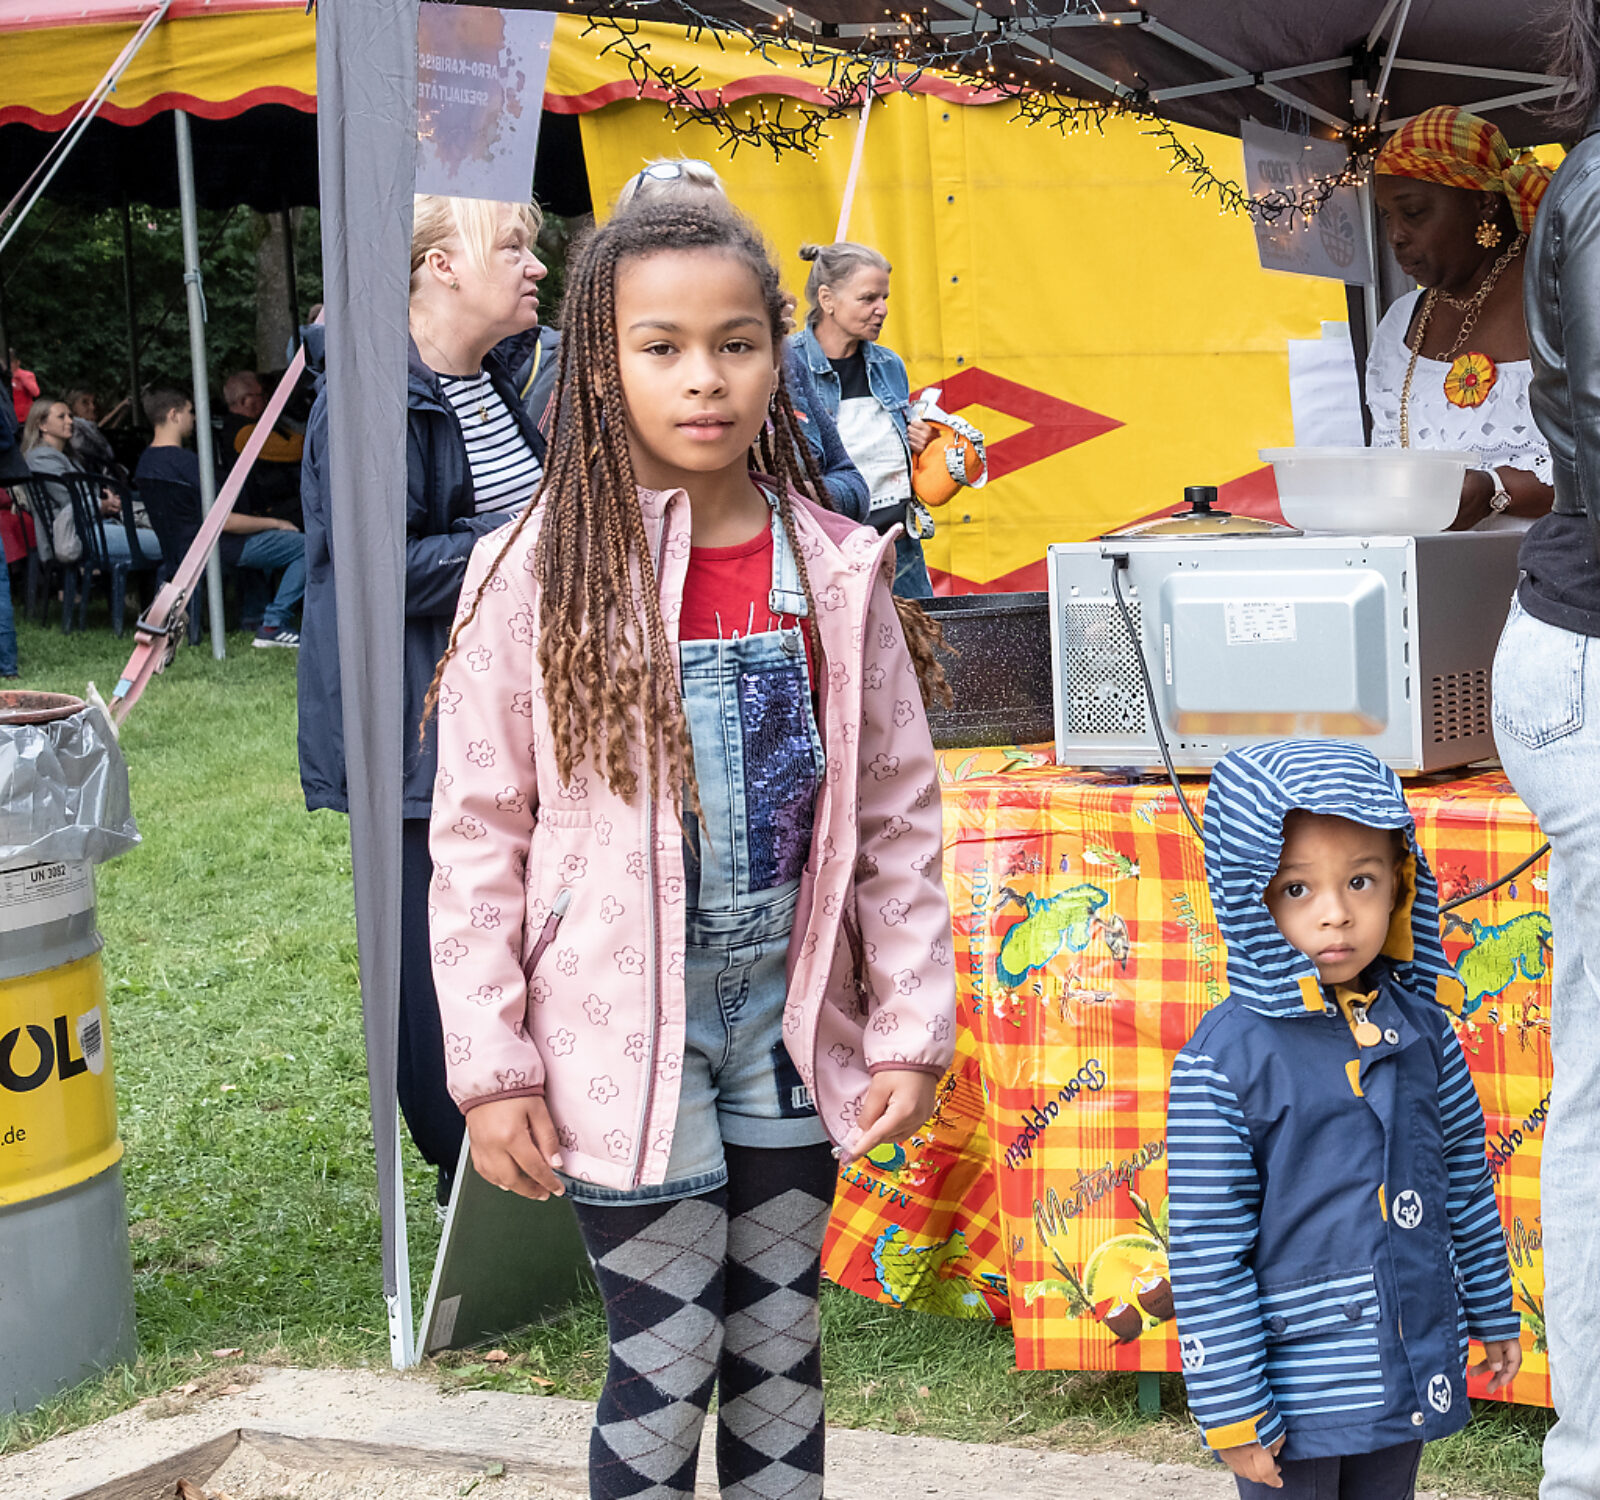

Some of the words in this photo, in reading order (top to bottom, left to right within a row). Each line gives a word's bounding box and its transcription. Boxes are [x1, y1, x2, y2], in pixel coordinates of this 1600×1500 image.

[31, 870, 45, 882] UN
[970, 860, 992, 1015] MARTINIQUE
[1059, 1058, 1107, 1102] Bon
[1004, 1103, 1060, 1171] appétit
[840, 1166, 914, 1209] MARTI
[1033, 1140, 1166, 1247] Martinique
